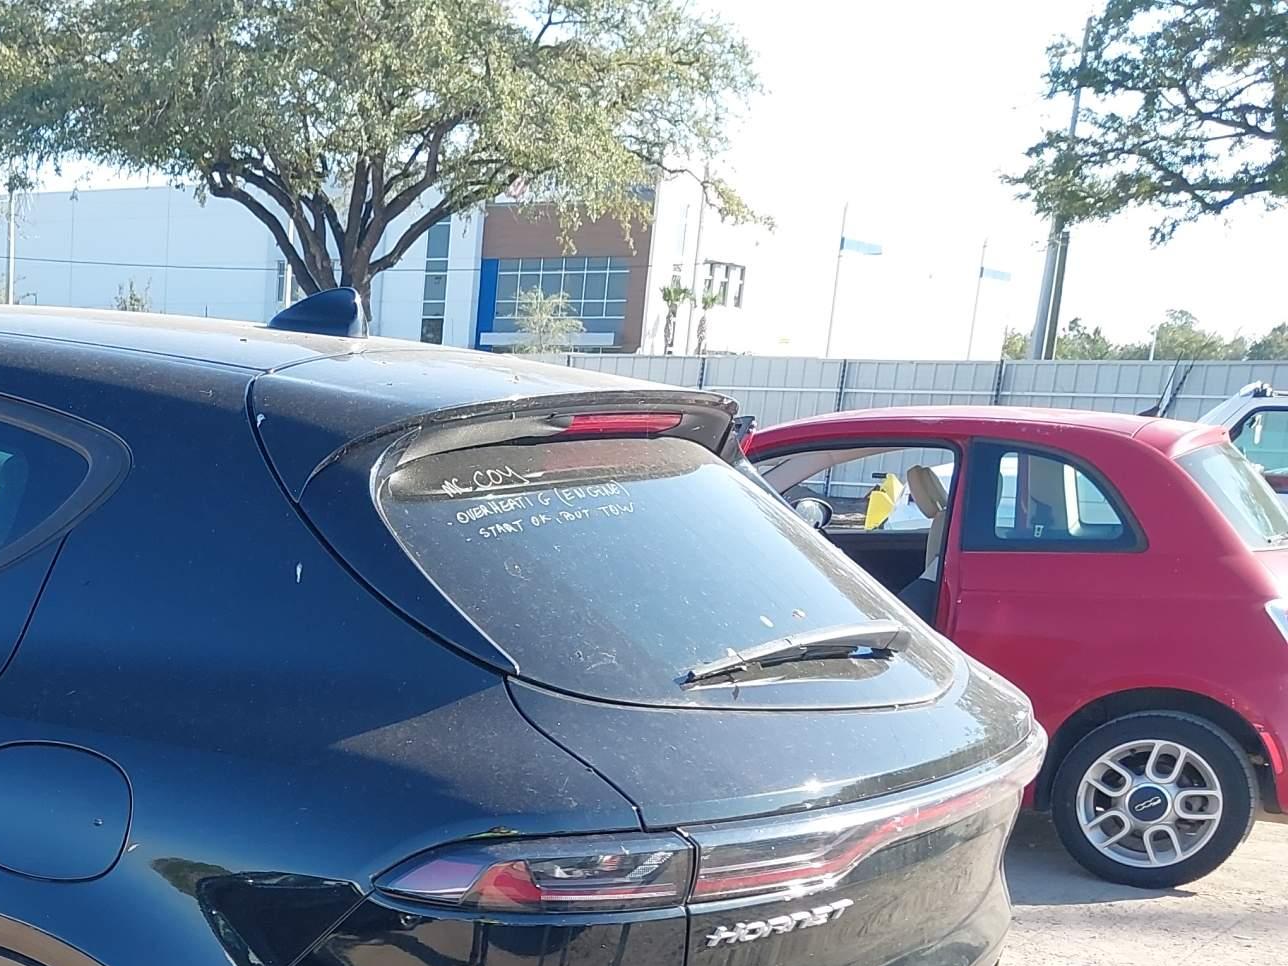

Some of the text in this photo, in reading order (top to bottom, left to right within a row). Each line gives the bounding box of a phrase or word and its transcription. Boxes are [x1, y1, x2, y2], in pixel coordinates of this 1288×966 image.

[479, 518, 523, 539] START
[598, 502, 635, 518] TOW
[705, 897, 856, 947] HORNET
